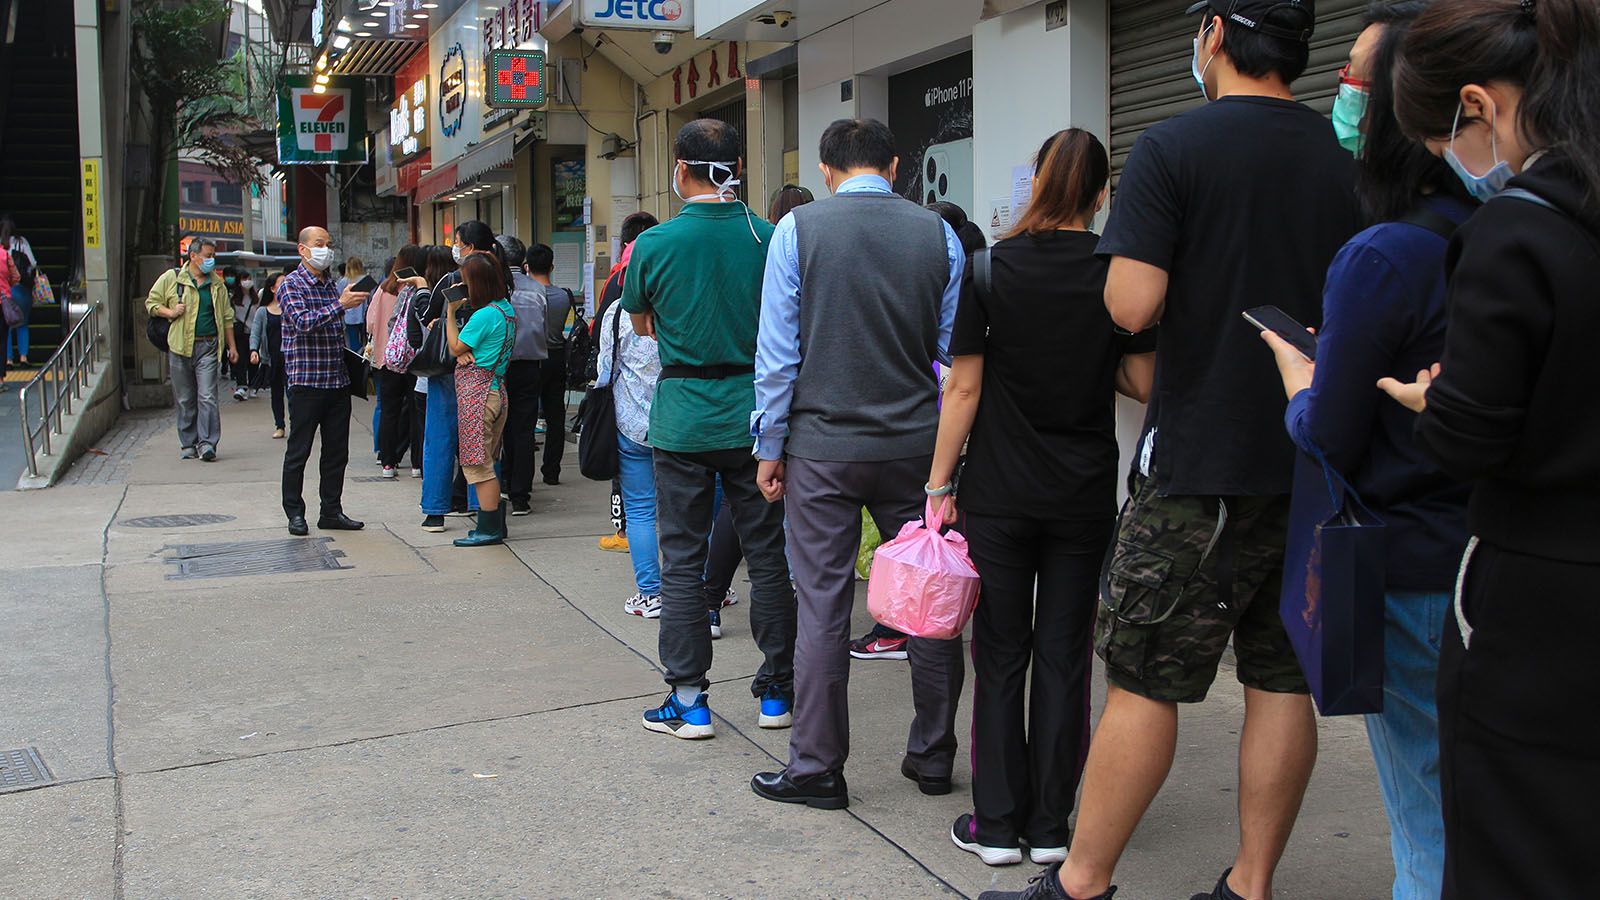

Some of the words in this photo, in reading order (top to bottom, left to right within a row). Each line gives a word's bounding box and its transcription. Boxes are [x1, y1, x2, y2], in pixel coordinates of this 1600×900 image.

[1230, 12, 1256, 28] DODGERS
[930, 86, 959, 106] iPhone
[958, 79, 966, 98] 11
[300, 94, 345, 152] 7
[189, 218, 221, 233] DELTA
[223, 221, 245, 234] ASIA
